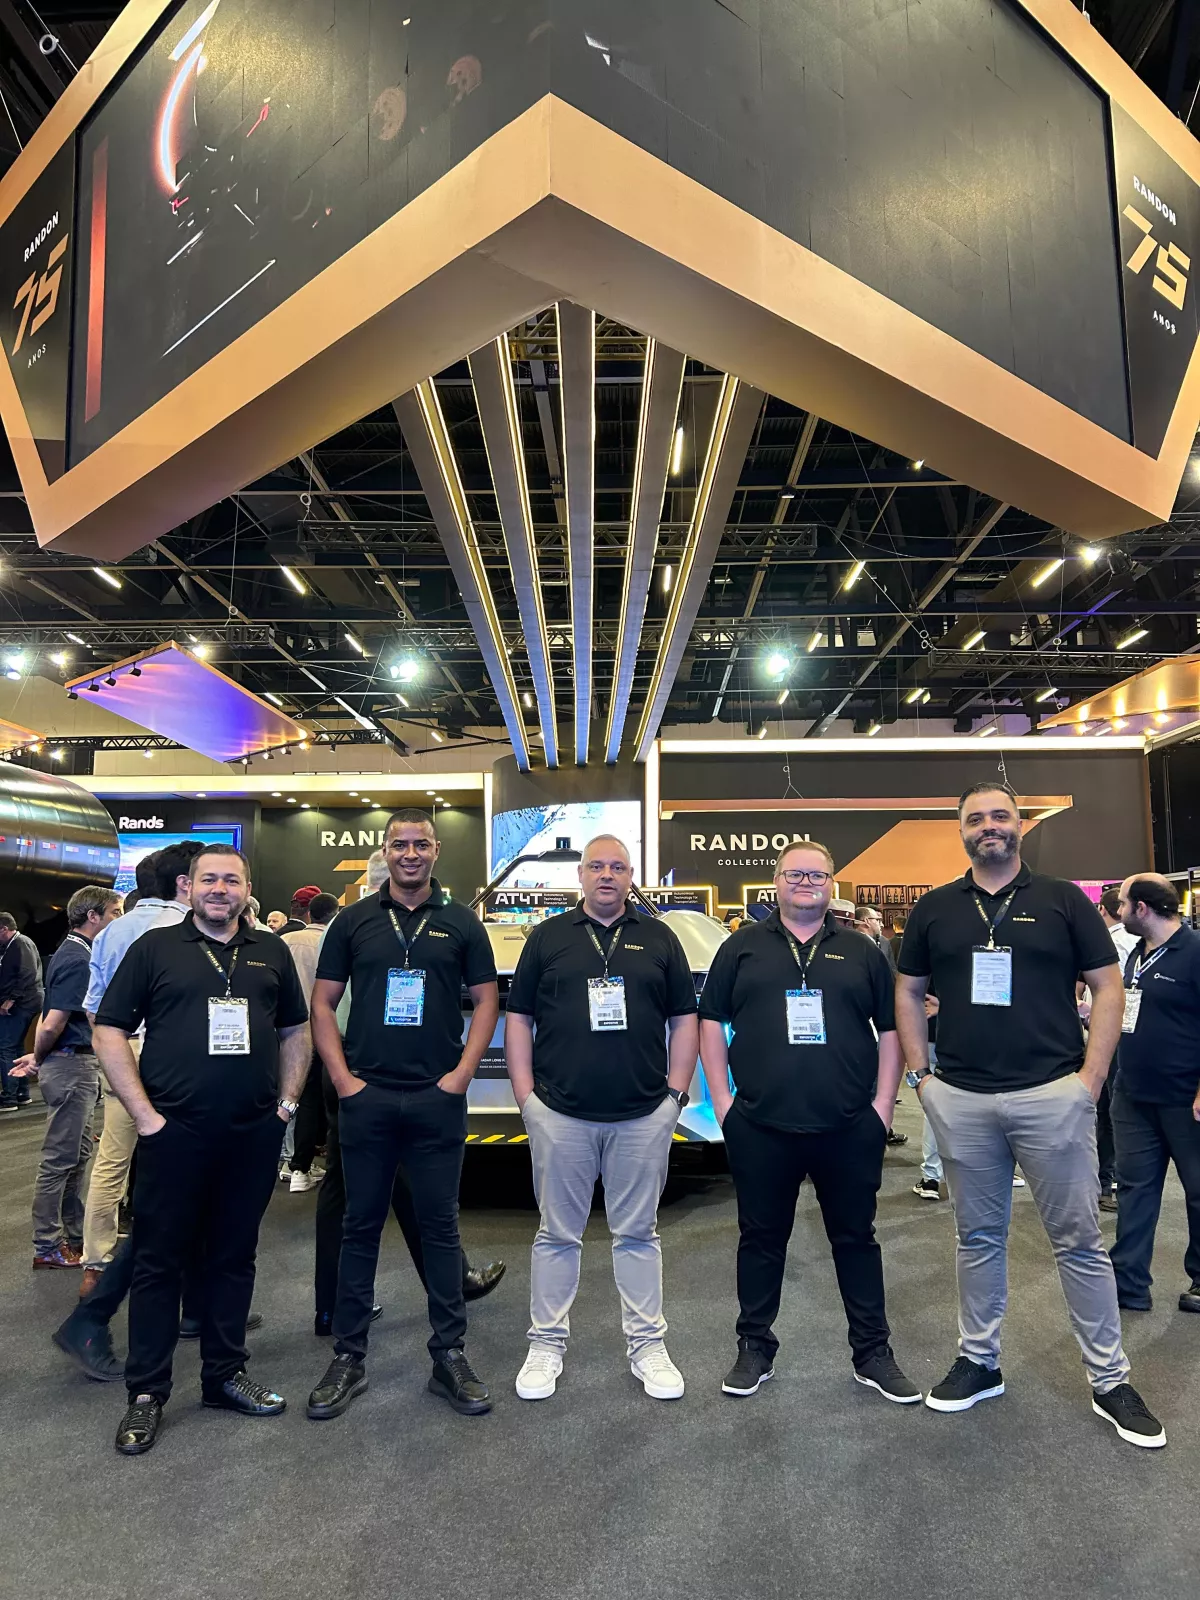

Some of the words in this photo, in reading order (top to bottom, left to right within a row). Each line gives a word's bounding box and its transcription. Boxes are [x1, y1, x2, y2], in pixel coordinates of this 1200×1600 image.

[1133, 175, 1177, 226] RANDON
[24, 211, 60, 262] RANDON
[1122, 204, 1191, 311] 75
[12, 233, 69, 356] 75
[1152, 310, 1177, 335] ANOS
[27, 343, 47, 368] ANOS
[119, 815, 164, 829] Rands
[495, 892, 542, 905] AT4T
